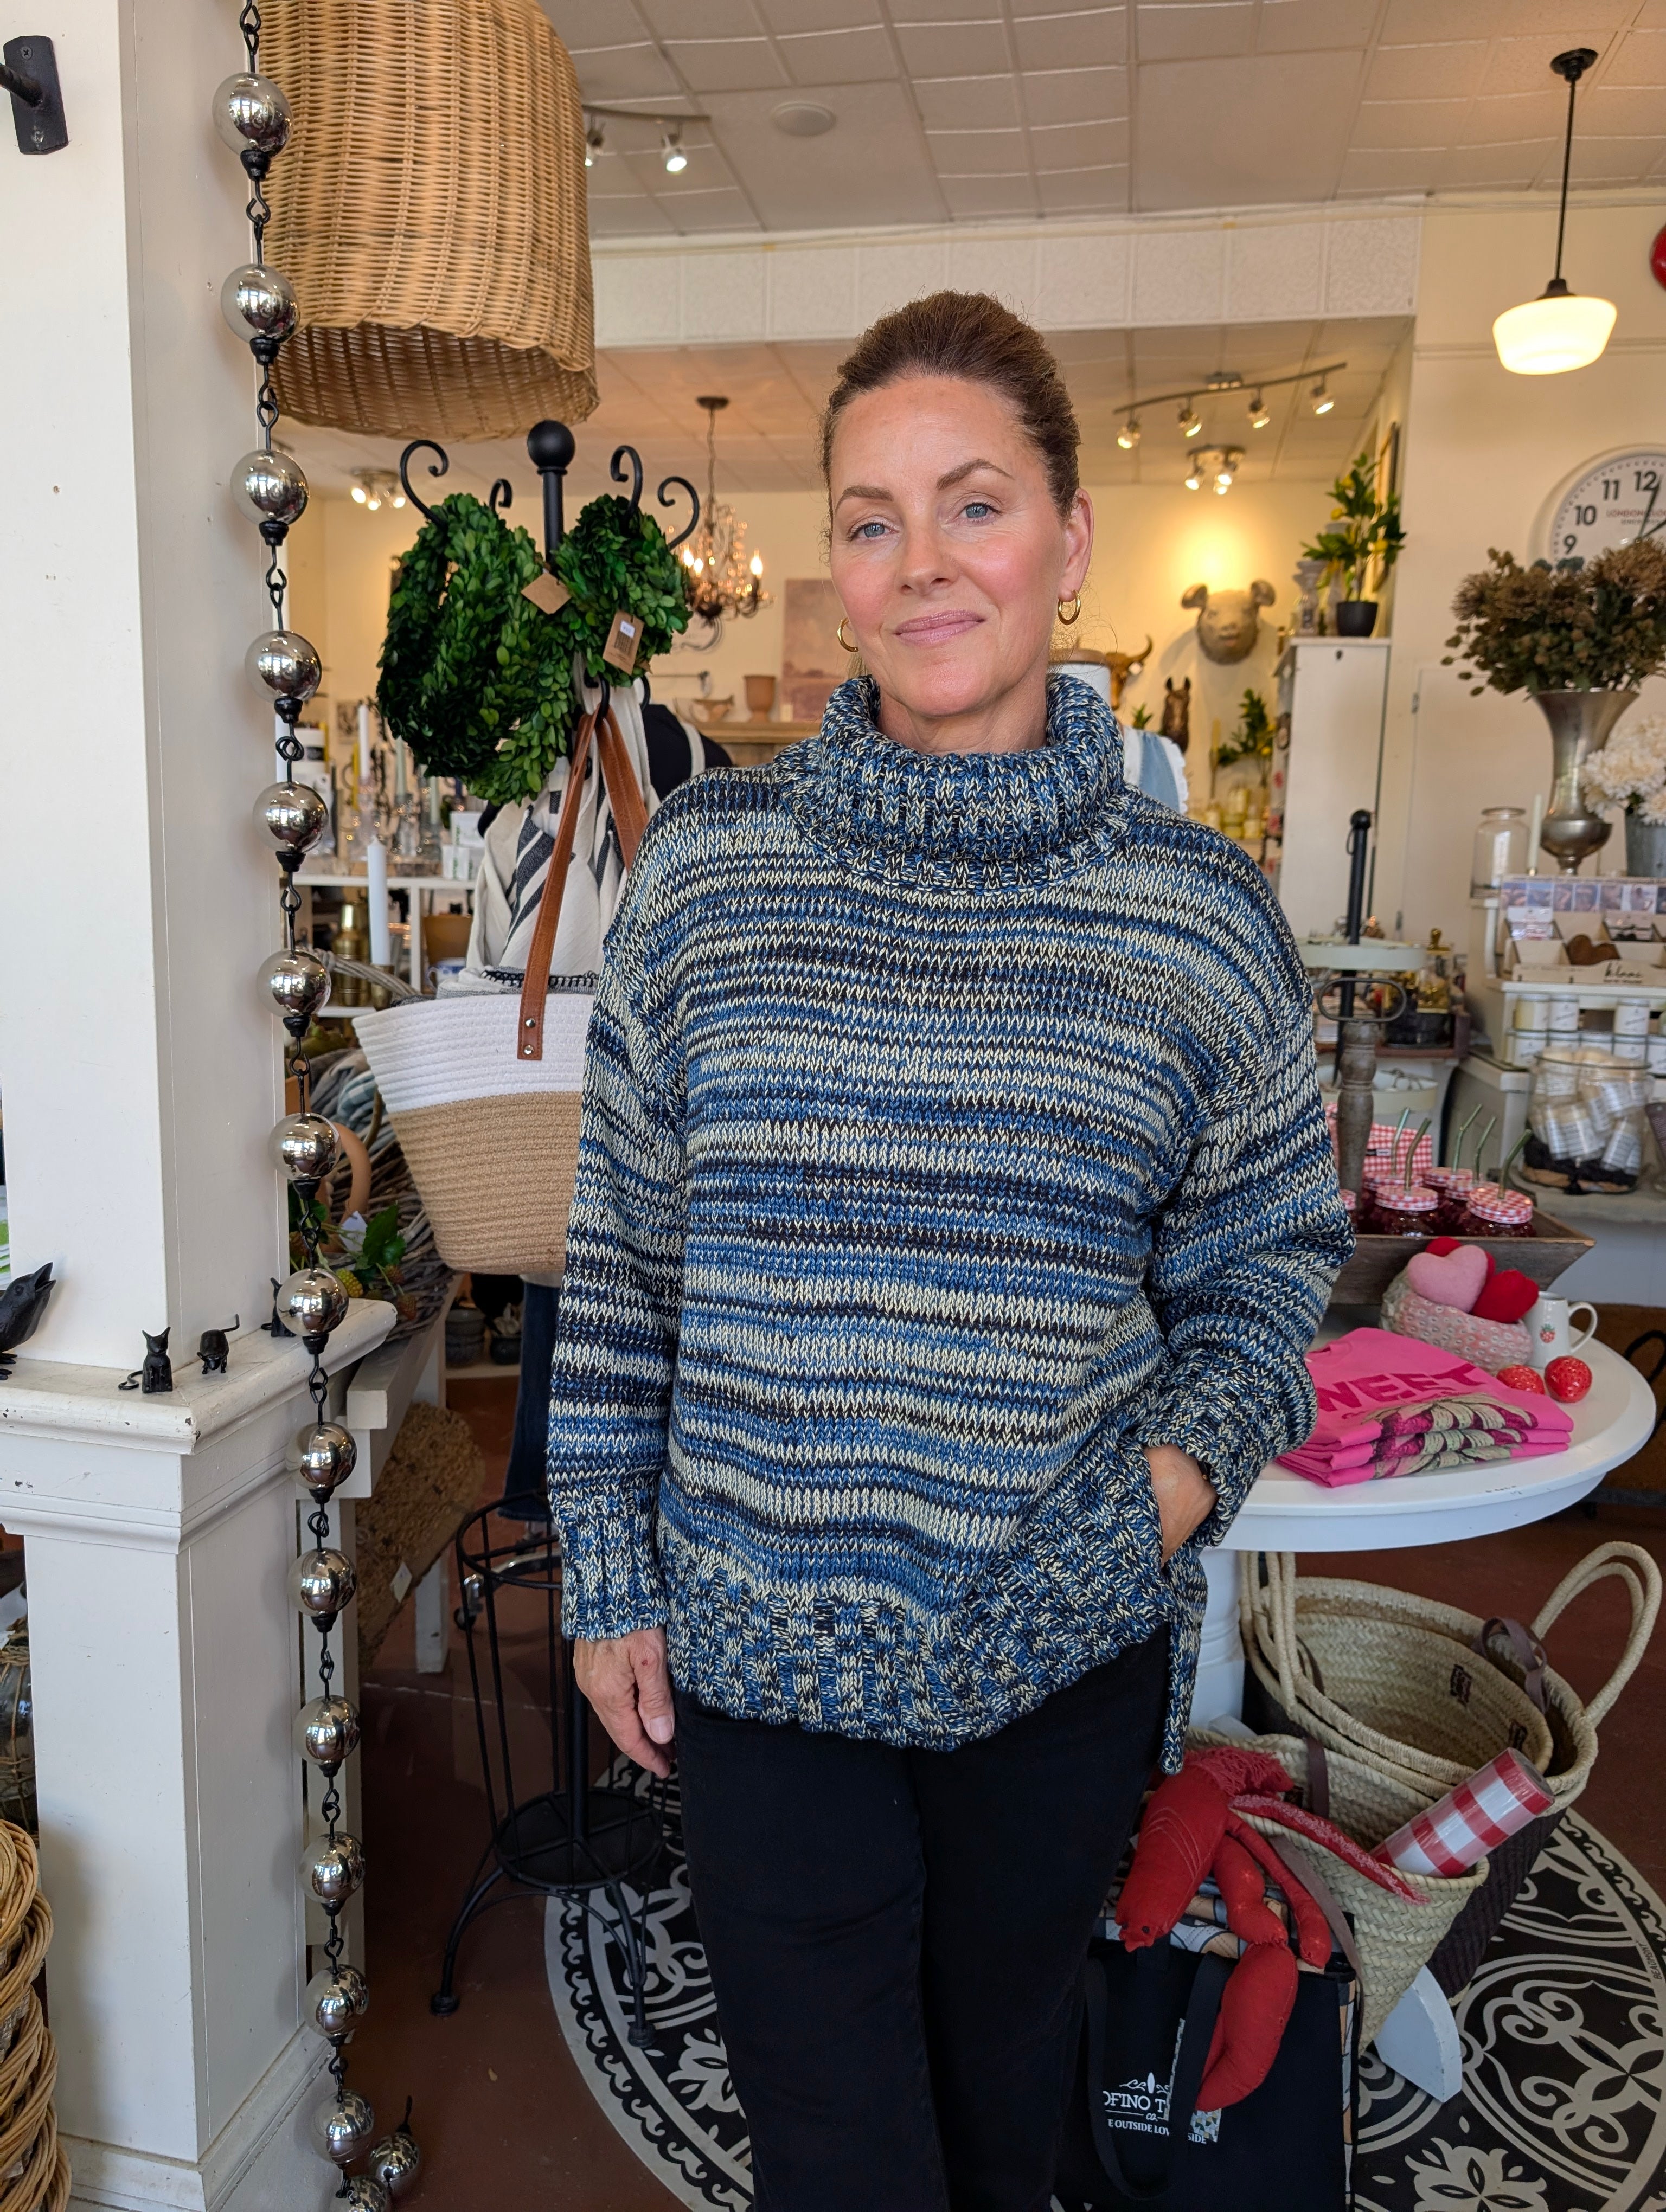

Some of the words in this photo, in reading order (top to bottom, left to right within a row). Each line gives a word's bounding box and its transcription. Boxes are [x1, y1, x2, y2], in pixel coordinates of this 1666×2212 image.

[1602, 479, 1620, 501] 11
[1634, 470, 1657, 492] 12
[1574, 505, 1597, 526] 10
[1564, 534, 1577, 555] 9
[1114, 2119, 1153, 2133] OUTSIDE
